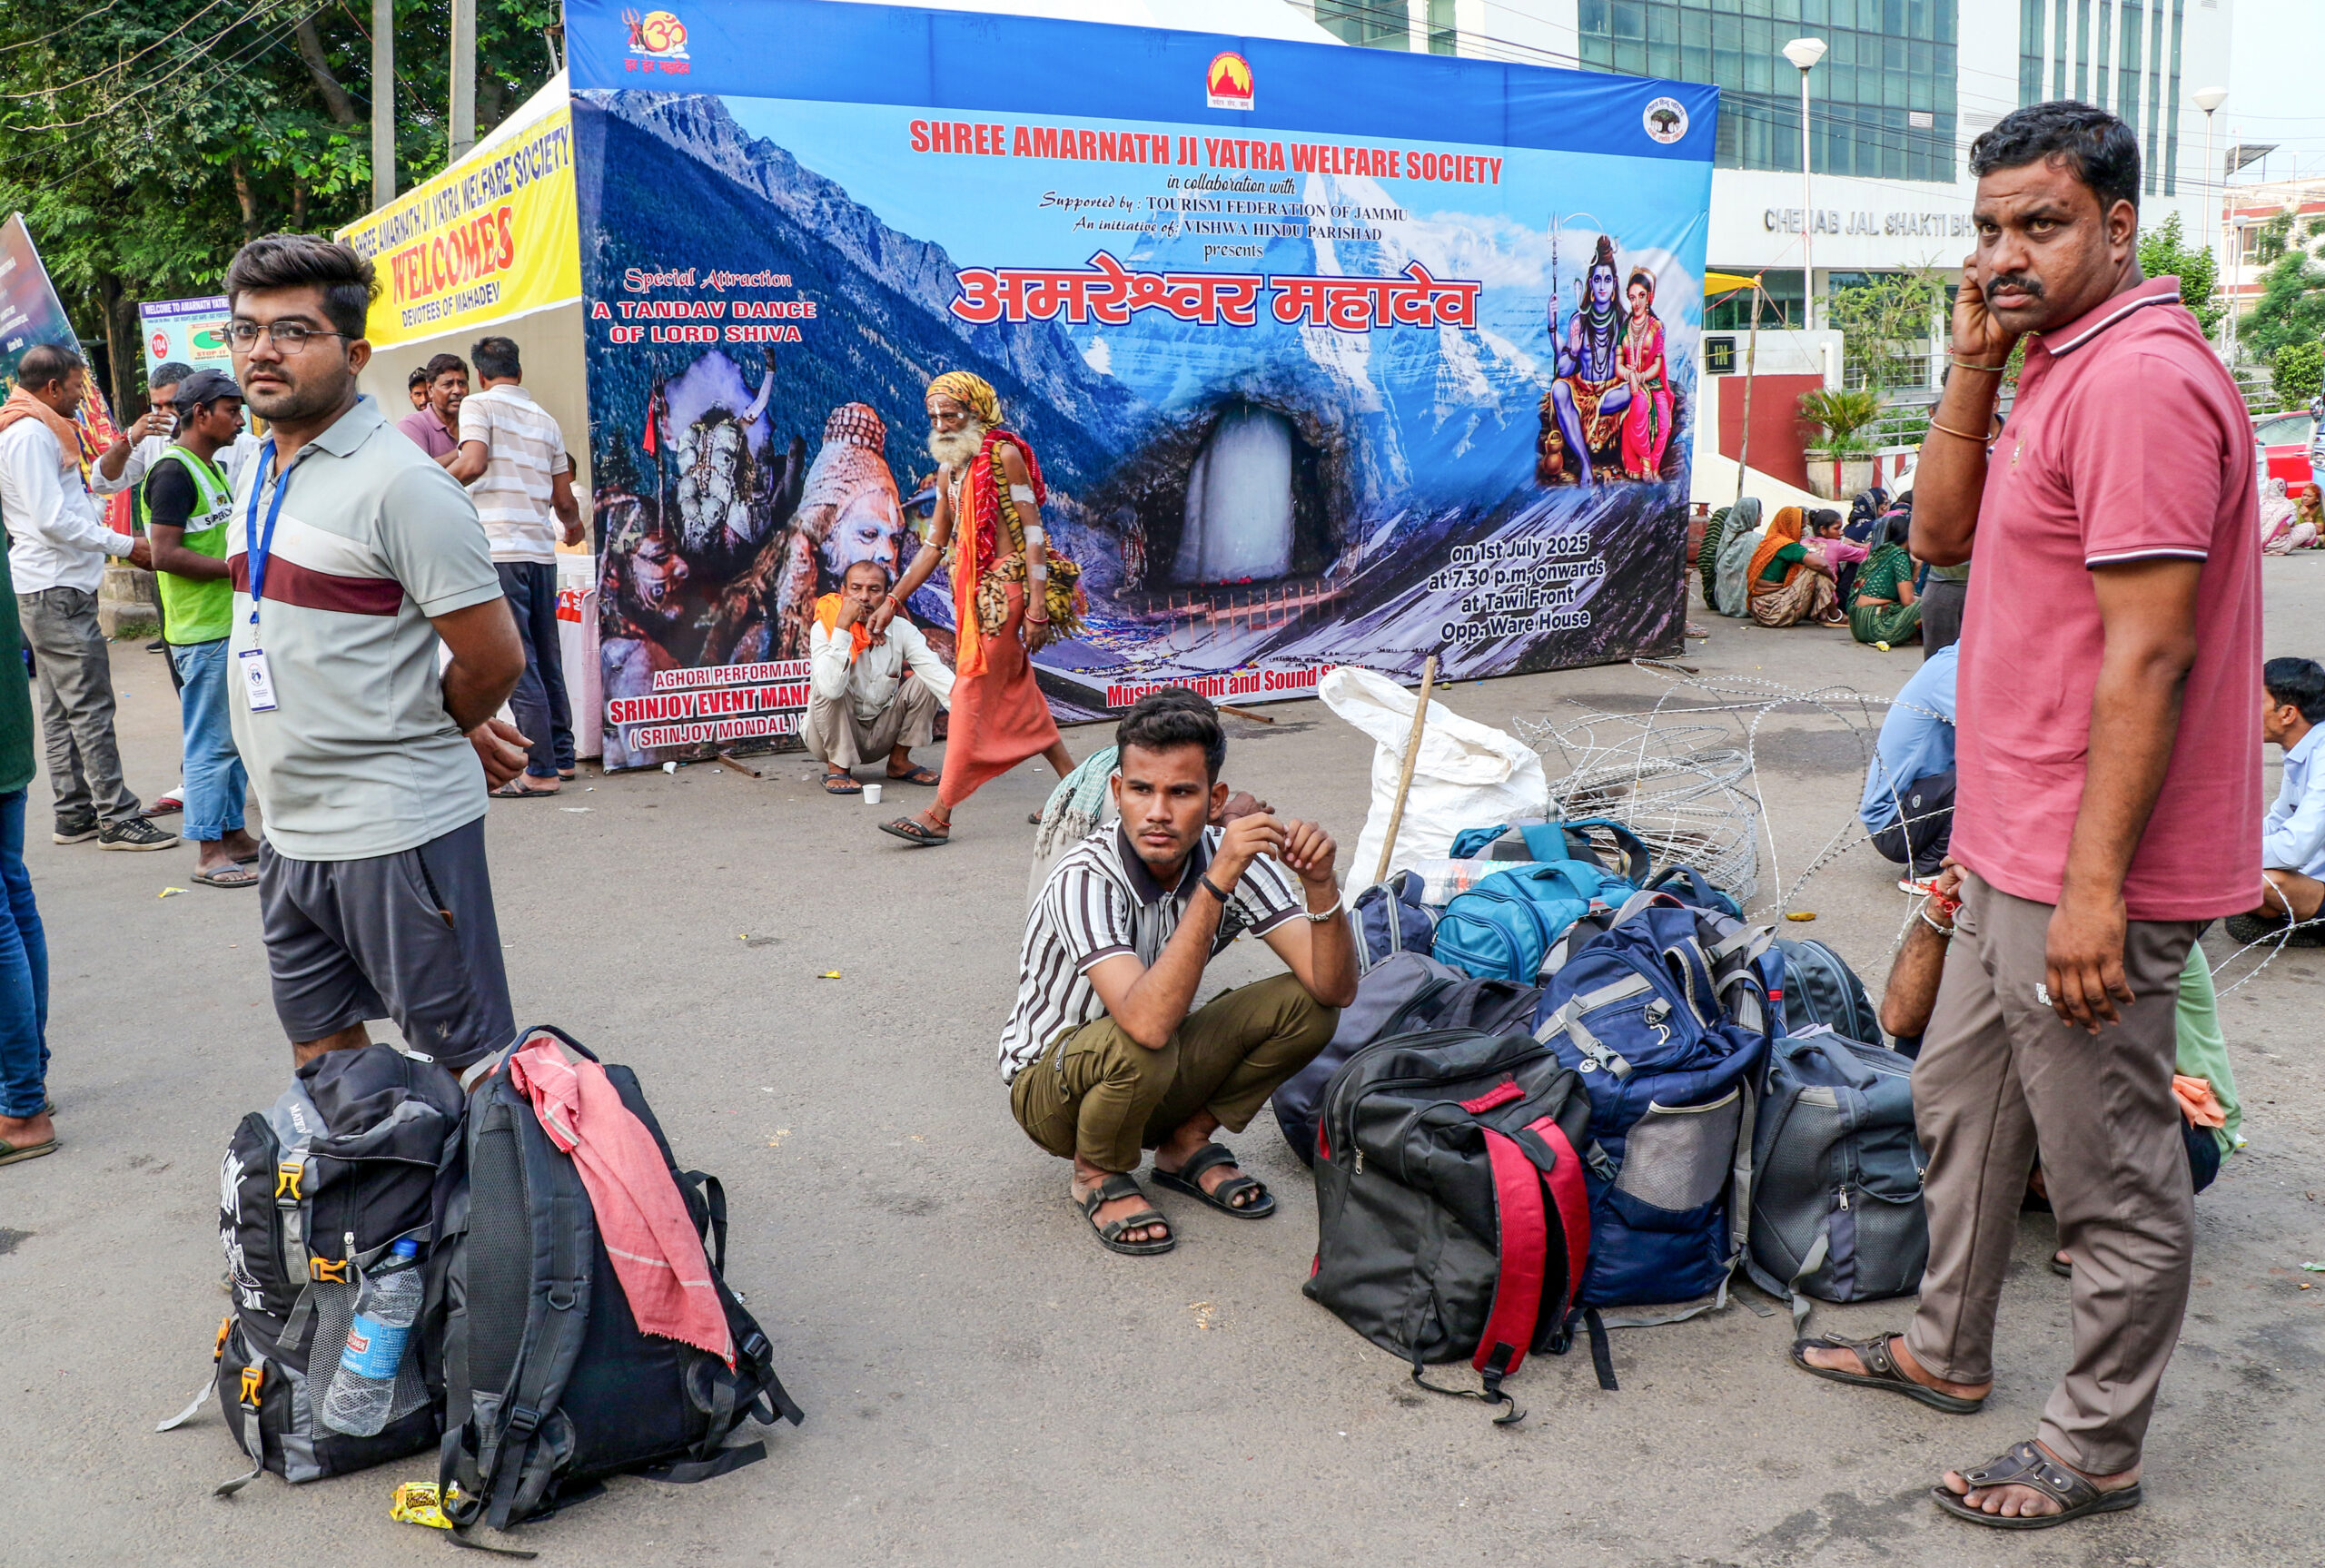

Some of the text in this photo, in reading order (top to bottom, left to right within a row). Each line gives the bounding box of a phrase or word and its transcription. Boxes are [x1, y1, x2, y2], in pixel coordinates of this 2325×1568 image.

[909, 120, 1504, 185] SHREE AMARNATH JI YATRA WELFARE SOCIETY
[354, 123, 569, 259] SHREE AMARNATH JI YATRA WELFARE SOCIETY
[1167, 173, 1296, 194] in collaboration with
[1039, 191, 1115, 211] Supported
[1146, 196, 1222, 212] TOURISM
[1226, 200, 1327, 219] FEDERATION
[1331, 205, 1351, 220] OF
[1354, 207, 1409, 222] JAMMU
[1072, 216, 1094, 232] An
[1098, 219, 1156, 232] initiative
[1184, 220, 1248, 236] VISHWA
[1252, 222, 1304, 238] HINDU
[1307, 225, 1382, 242] PARISHAD
[1845, 212, 1880, 235] JAL
[1885, 212, 1947, 237] SHAKTI
[391, 206, 515, 305] WELCOMES
[1204, 242, 1264, 262] presents
[624, 267, 793, 293] Special Attraction
[949, 250, 1482, 332] अमरेश्वर महादेव
[145, 302, 173, 315] WELCOME
[173, 301, 181, 313] TO
[181, 300, 212, 312] AMARNATH
[401, 281, 500, 328] DEVOTEES OF MAHADEV
[591, 301, 817, 320] A TANDAV DANCE
[152, 338, 167, 352] 104
[609, 324, 803, 343] OF LORD SHIVA
[1715, 344, 1728, 365] IN
[1451, 533, 1589, 563] on 1st July 2025
[1428, 572, 1448, 590] at
[1452, 568, 1490, 588] 7.30
[1536, 557, 1606, 581] onwards
[1461, 585, 1575, 614] at Tawi Front
[1440, 609, 1591, 643] Opp. Ware House
[655, 670, 710, 688] AGHORI
[1229, 675, 1261, 695] and
[1264, 666, 1317, 690] Sound
[609, 694, 693, 724] SRINJOY
[698, 688, 757, 715] EVENT
